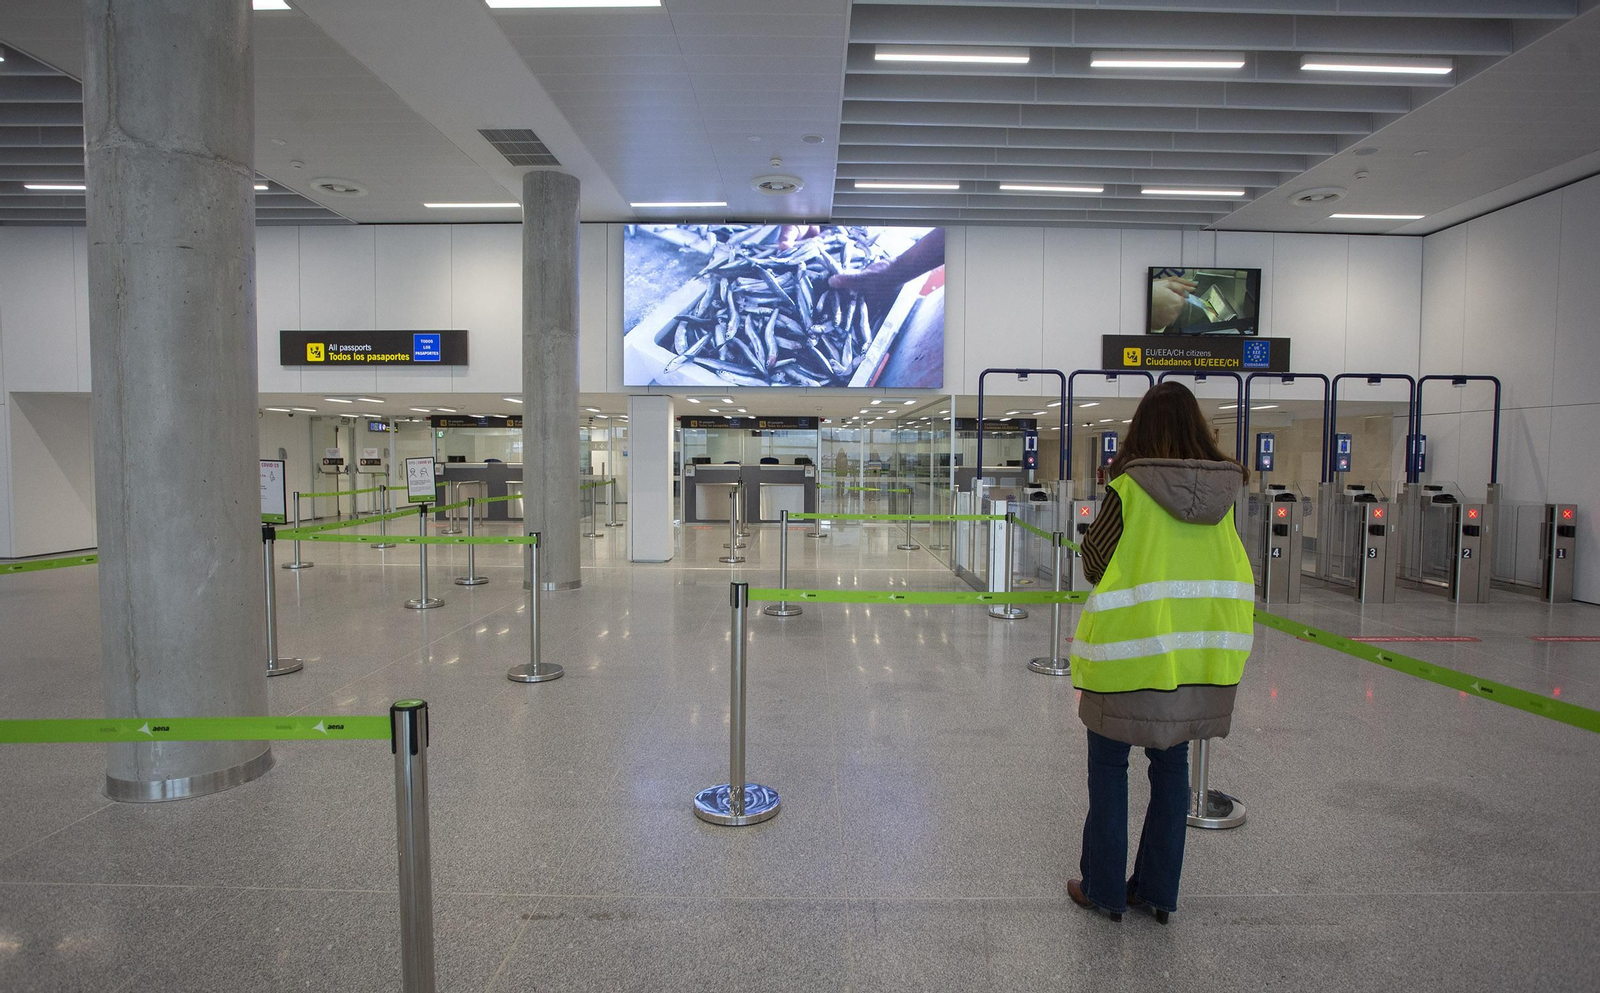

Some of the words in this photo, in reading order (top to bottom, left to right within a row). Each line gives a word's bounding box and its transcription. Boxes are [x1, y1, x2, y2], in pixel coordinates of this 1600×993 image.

[328, 344, 337, 352] All
[340, 344, 372, 352] passports
[1145, 348, 1185, 357] EU/EEA/CH
[1186, 349, 1212, 358] citizens
[328, 352, 351, 360] Todos
[354, 352, 364, 360] los
[368, 352, 410, 362] pasaportes
[1146, 357, 1192, 366] Ciudadanos
[1194, 358, 1240, 368] UE/EEE/CH
[1272, 548, 1280, 558] 4
[1369, 548, 1376, 558] 3
[1463, 548, 1470, 558] 2
[1558, 548, 1564, 558] 1
